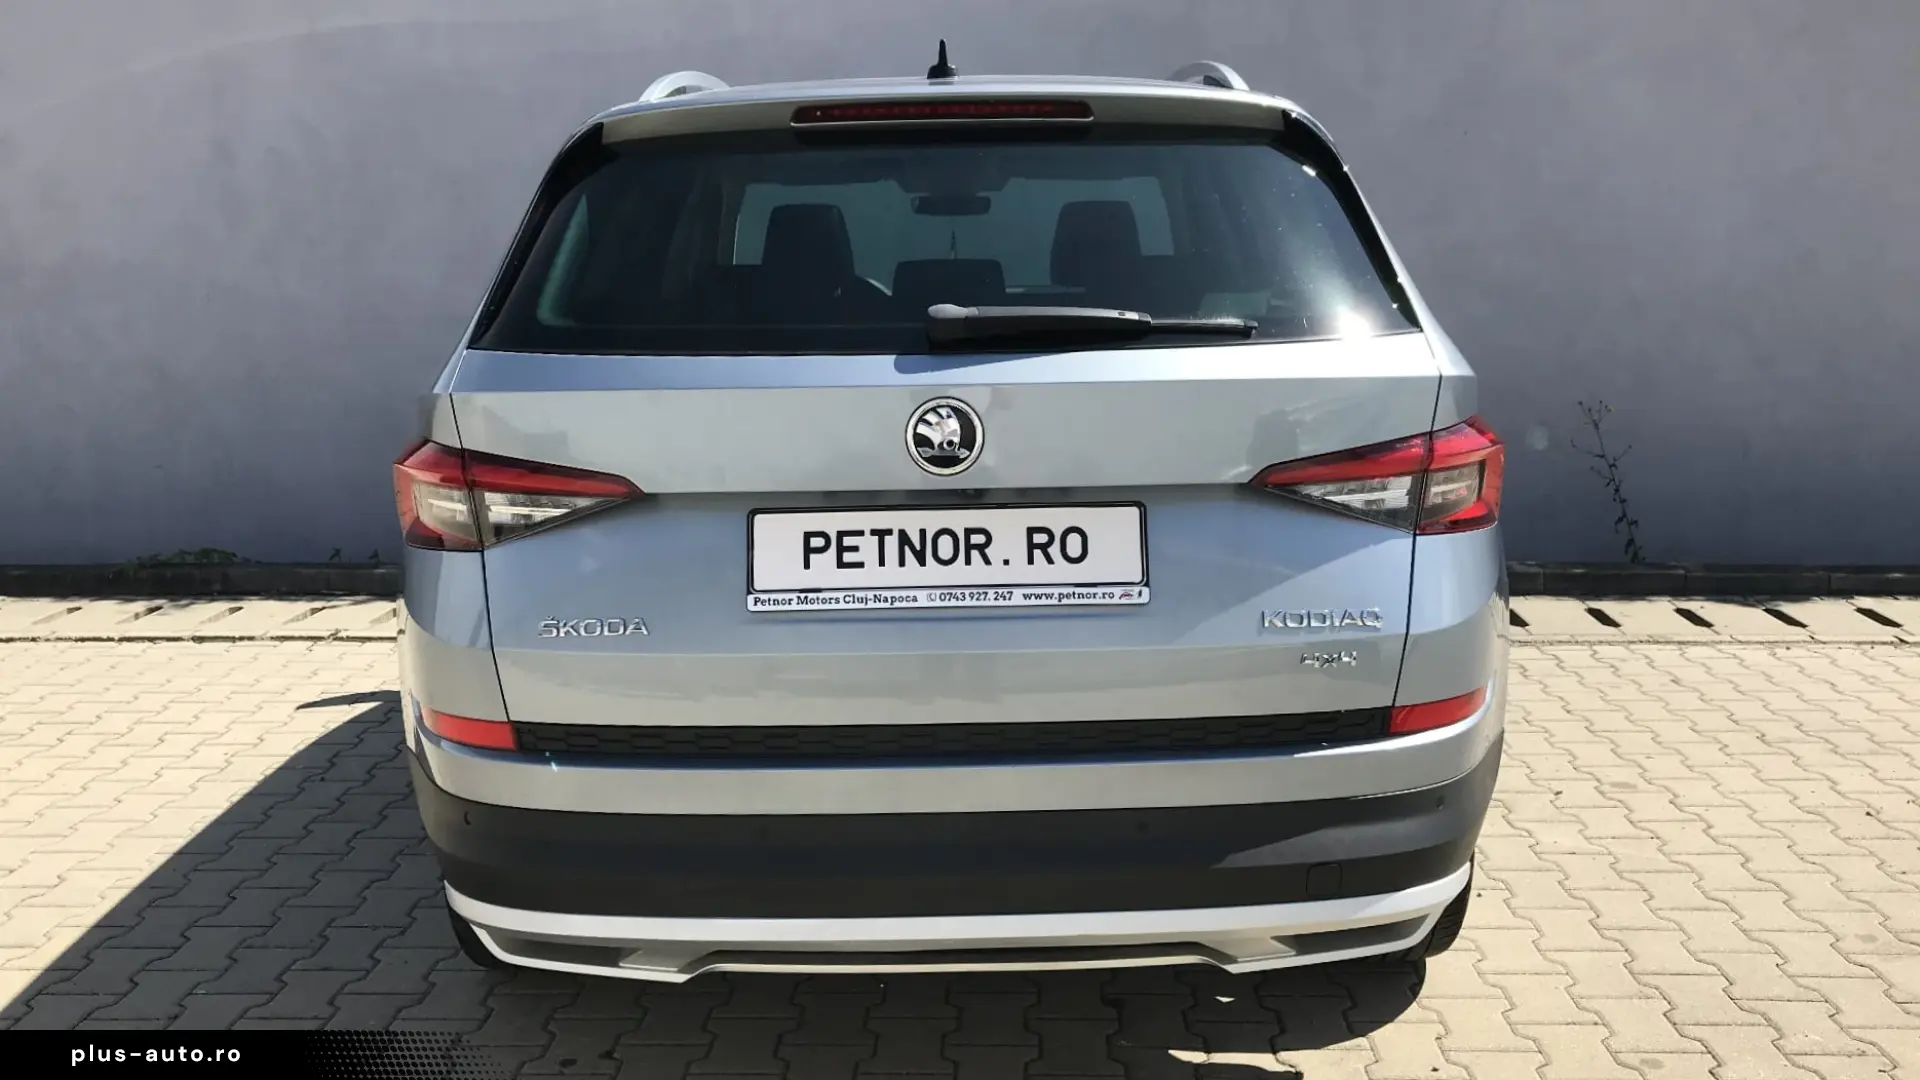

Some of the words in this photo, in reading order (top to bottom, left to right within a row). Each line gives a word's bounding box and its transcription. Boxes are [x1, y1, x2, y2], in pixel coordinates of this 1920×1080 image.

[753, 596, 793, 607] Petnor
[796, 594, 841, 605] Motors
[843, 593, 919, 605] Cluj-Napoca
[939, 591, 966, 602] 0743
[1022, 590, 1115, 602] www.petnor.ro
[538, 615, 650, 638] ŠKODA
[1261, 606, 1384, 628] KODIAQ
